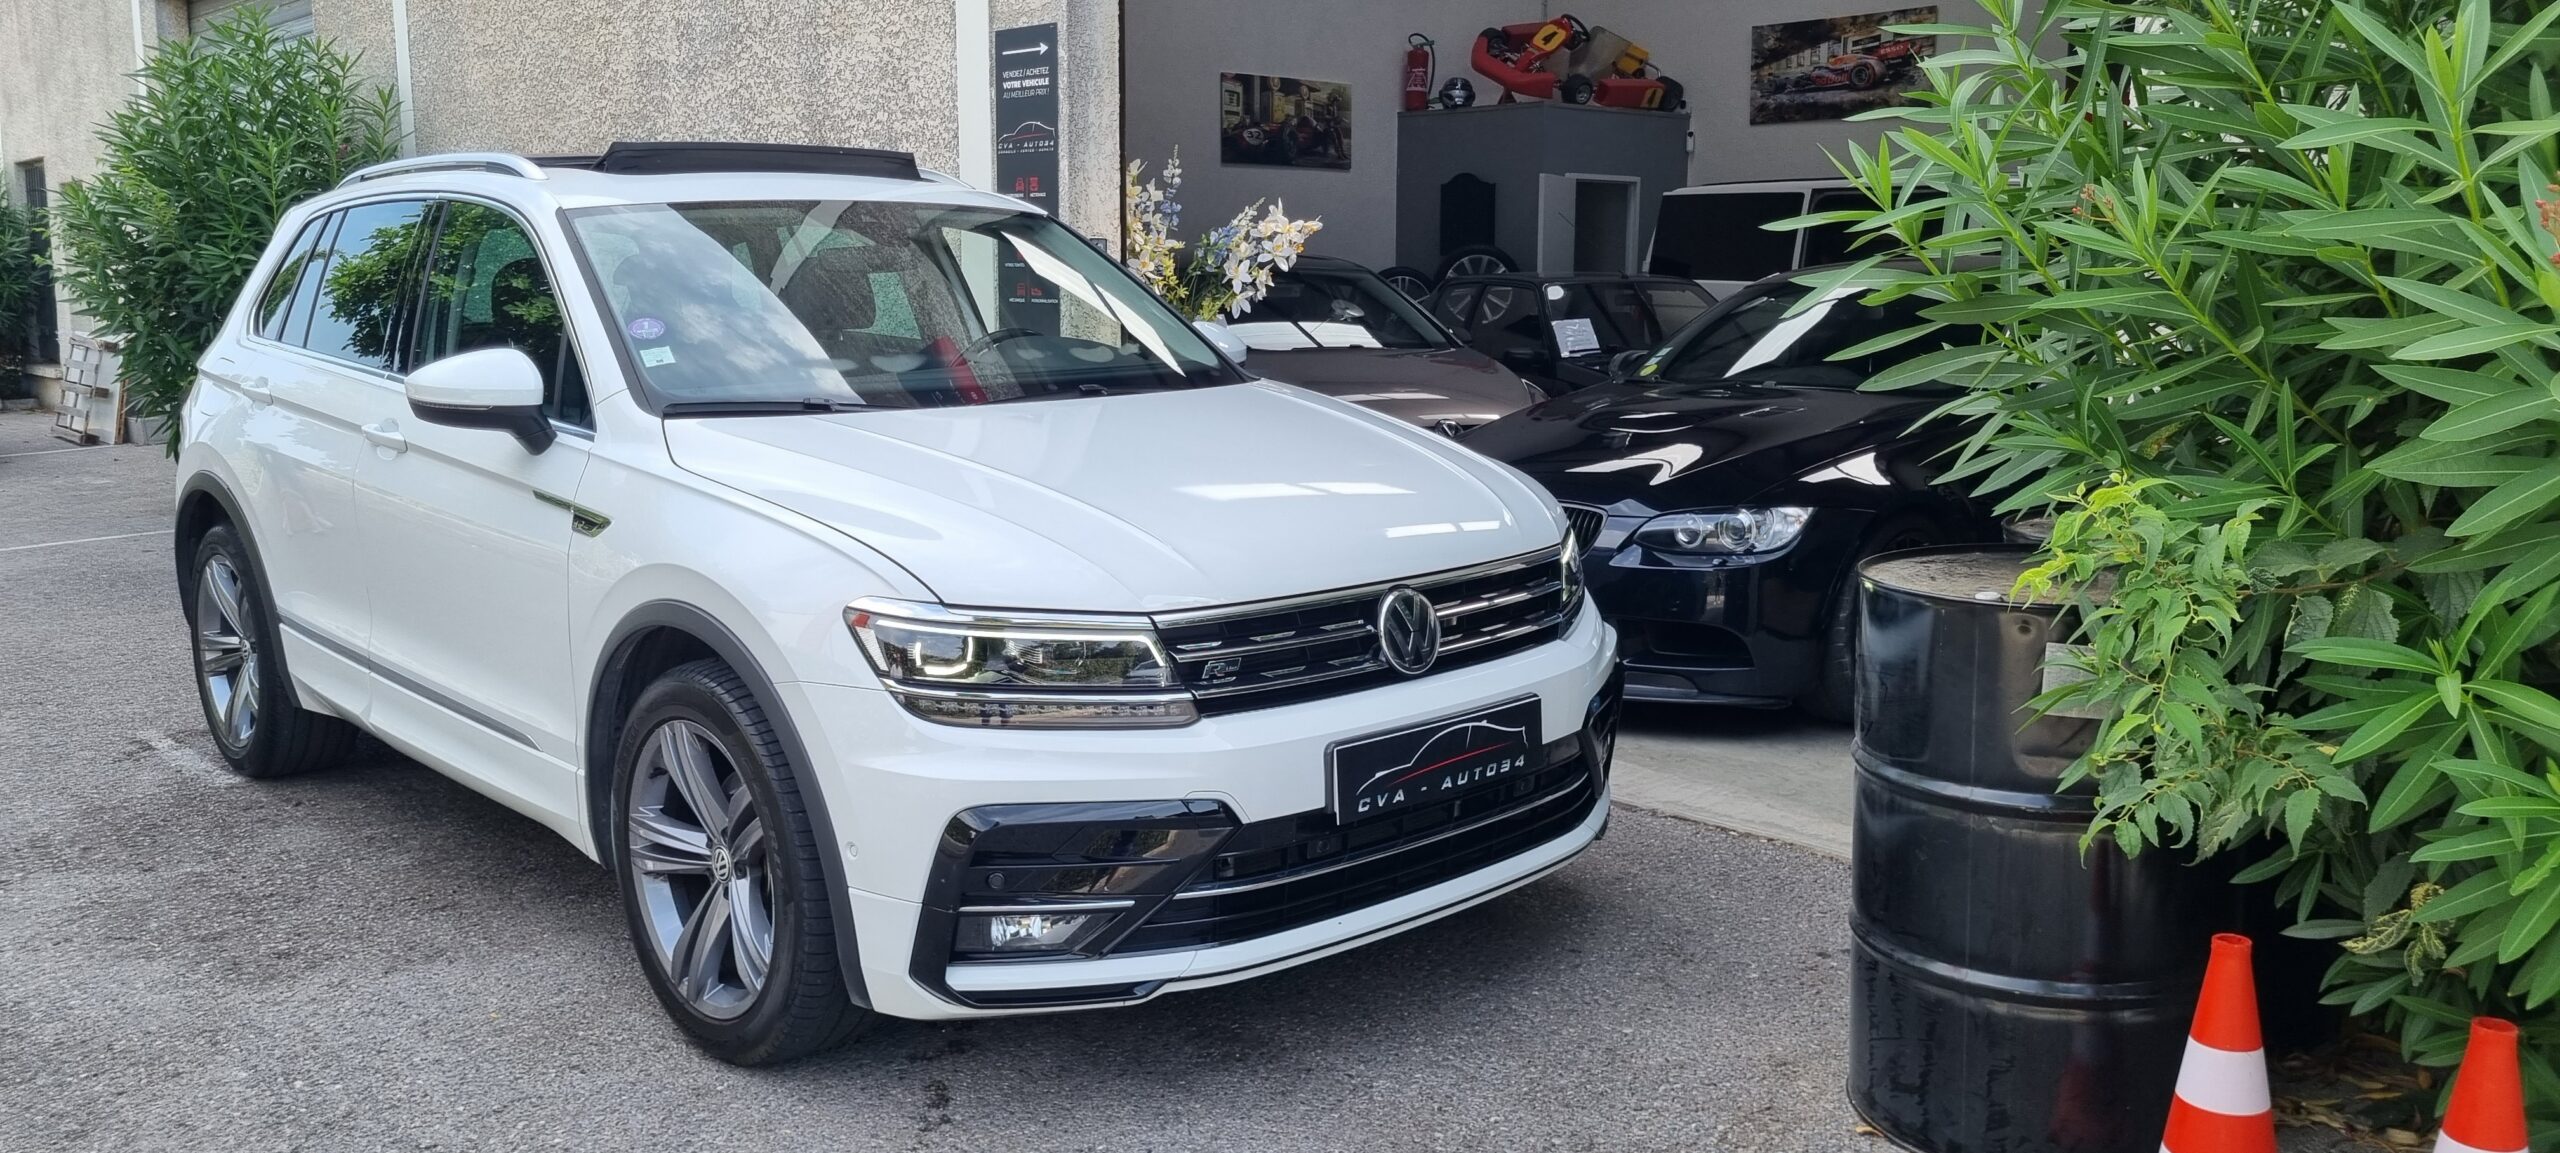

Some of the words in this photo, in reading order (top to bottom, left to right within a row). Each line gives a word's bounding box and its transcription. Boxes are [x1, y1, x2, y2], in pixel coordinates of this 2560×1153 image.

[1002, 80, 1021, 89] VOTRE
[1022, 77, 1050, 88] VEHICULE
[1003, 91, 1011, 99] AU
[1011, 89, 1035, 98] MEILLEUR
[1247, 130, 1262, 139] 32
[1023, 140, 1054, 148] AUTO34
[1358, 789, 1405, 813] CVA
[1441, 754, 1526, 790] AUTO34
